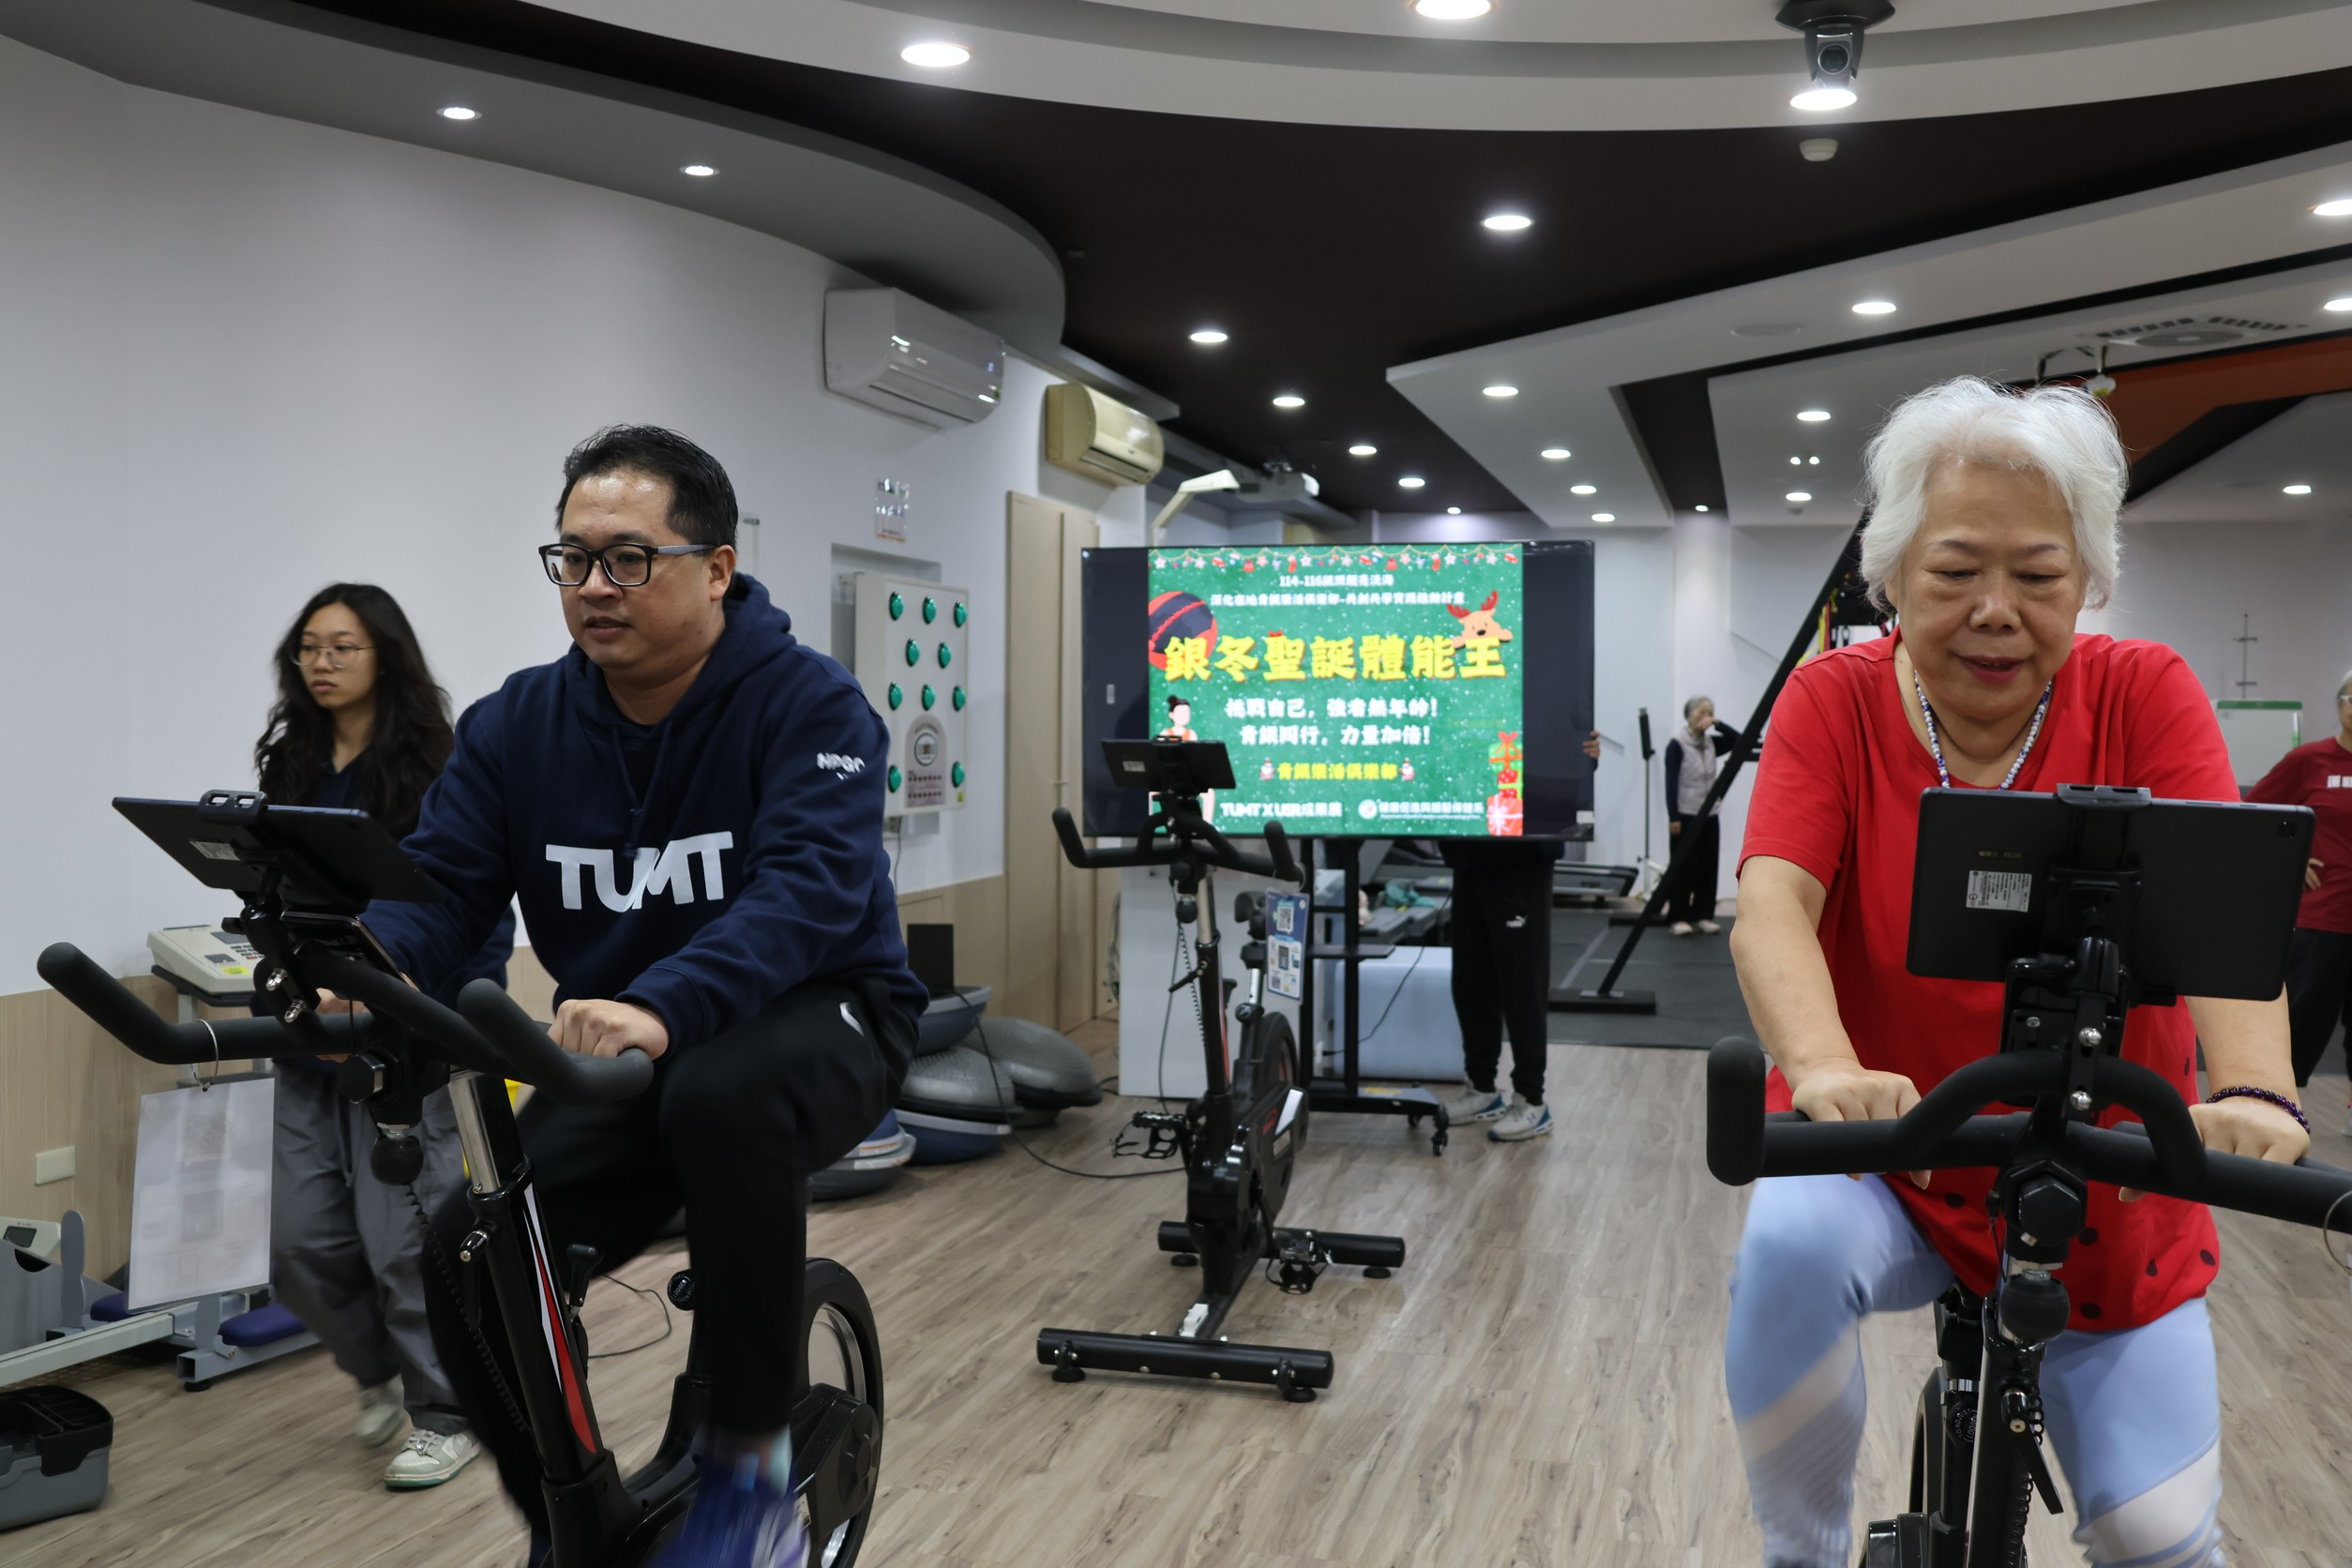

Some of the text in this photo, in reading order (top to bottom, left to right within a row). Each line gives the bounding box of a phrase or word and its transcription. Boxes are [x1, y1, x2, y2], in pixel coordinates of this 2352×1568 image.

[1164, 634, 1507, 682] 銀冬聖誕體能王
[1220, 802, 1261, 817] TUMT
[545, 831, 733, 912] TUMT
[1954, 1408, 1971, 1428] ADJUST
